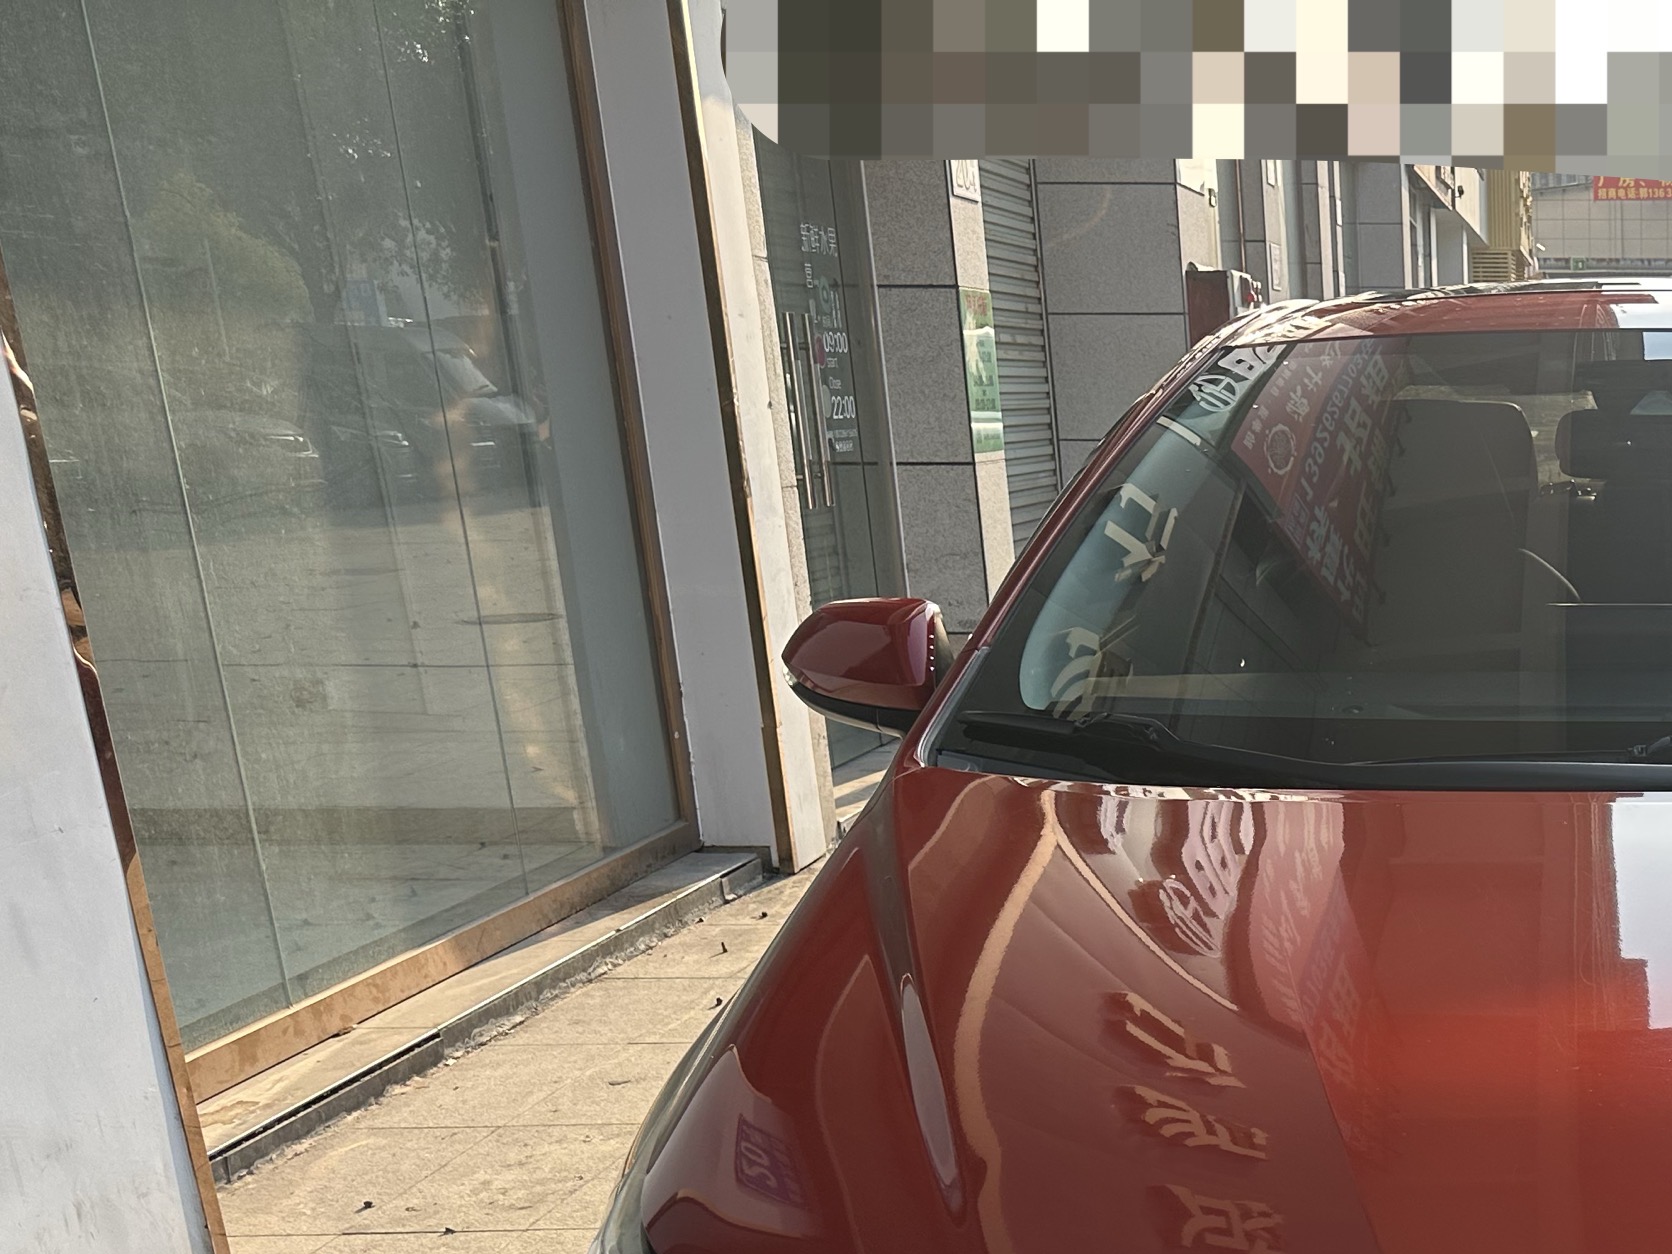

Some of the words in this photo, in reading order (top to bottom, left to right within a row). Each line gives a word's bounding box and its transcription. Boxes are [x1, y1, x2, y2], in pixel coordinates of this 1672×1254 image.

[800, 222, 838, 257] 新鲜水果
[823, 331, 849, 354] 09:00
[831, 395, 856, 420] 22:00
